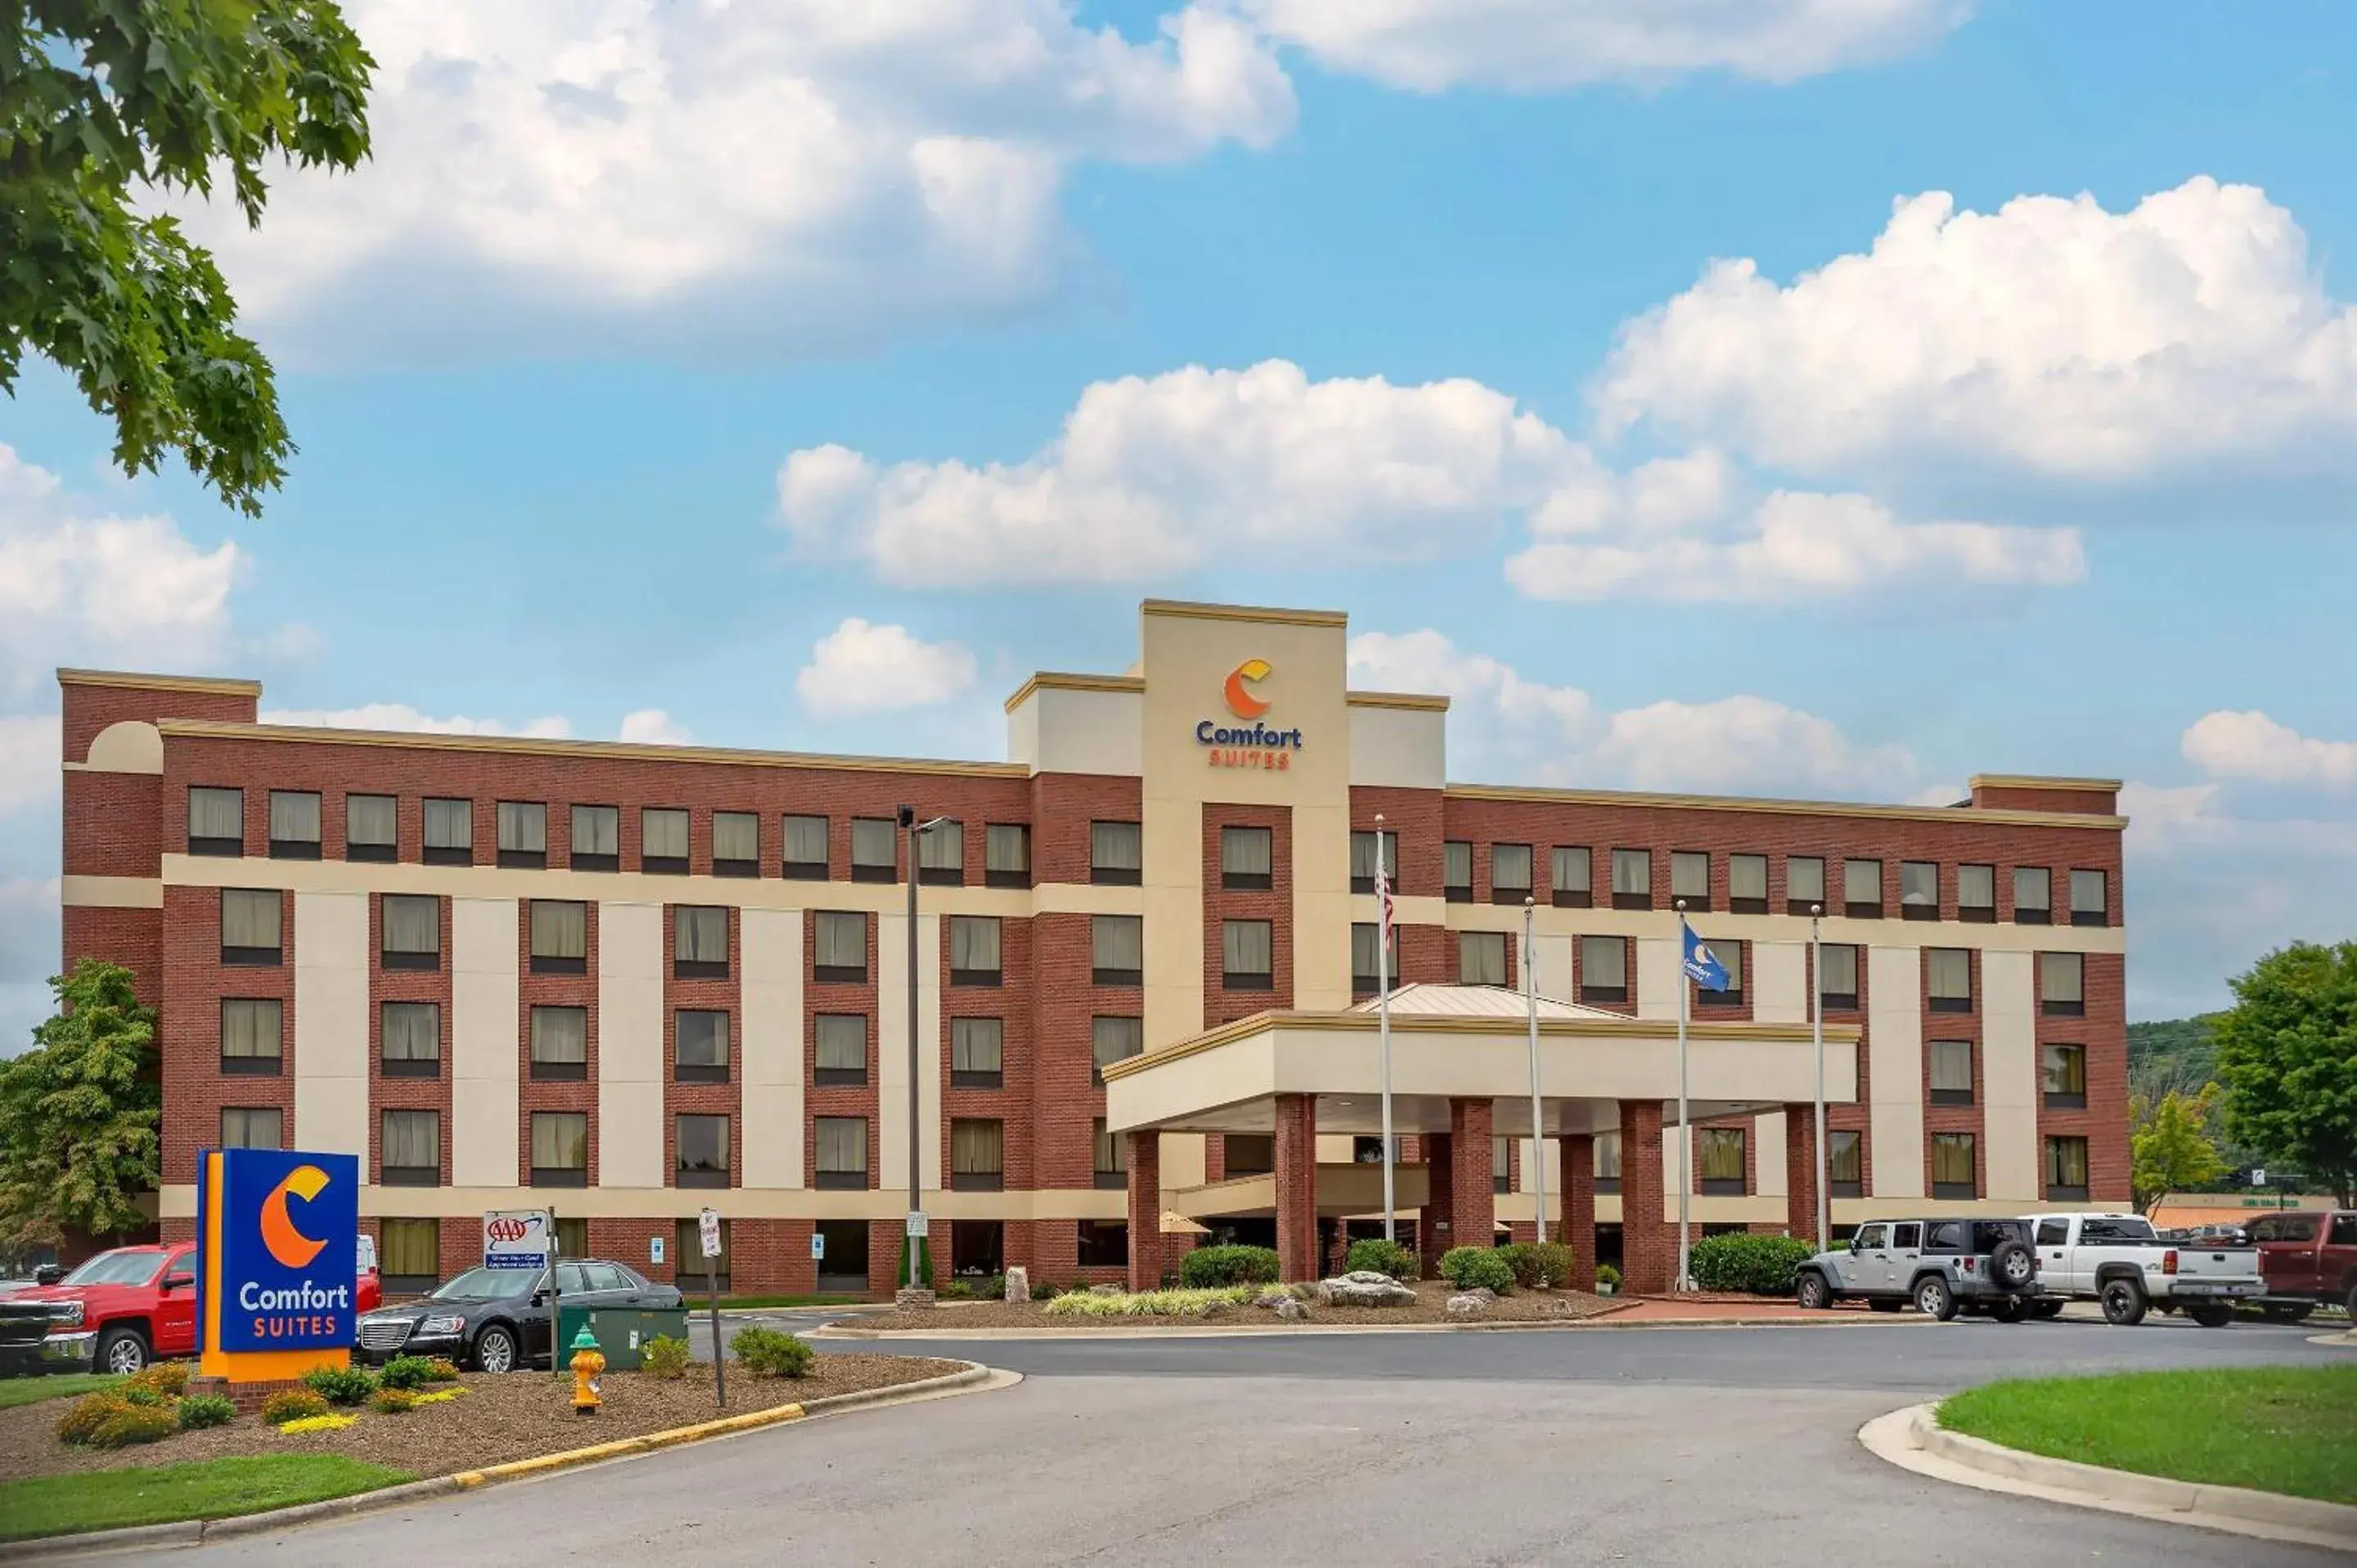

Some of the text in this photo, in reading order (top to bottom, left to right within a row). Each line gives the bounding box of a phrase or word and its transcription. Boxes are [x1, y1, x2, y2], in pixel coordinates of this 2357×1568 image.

[1197, 721, 1301, 748] Comfort
[1208, 750, 1289, 770] SUITES
[491, 1219, 525, 1241] AAA
[240, 1280, 348, 1310] Comfort
[254, 1316, 336, 1337] SUITES
